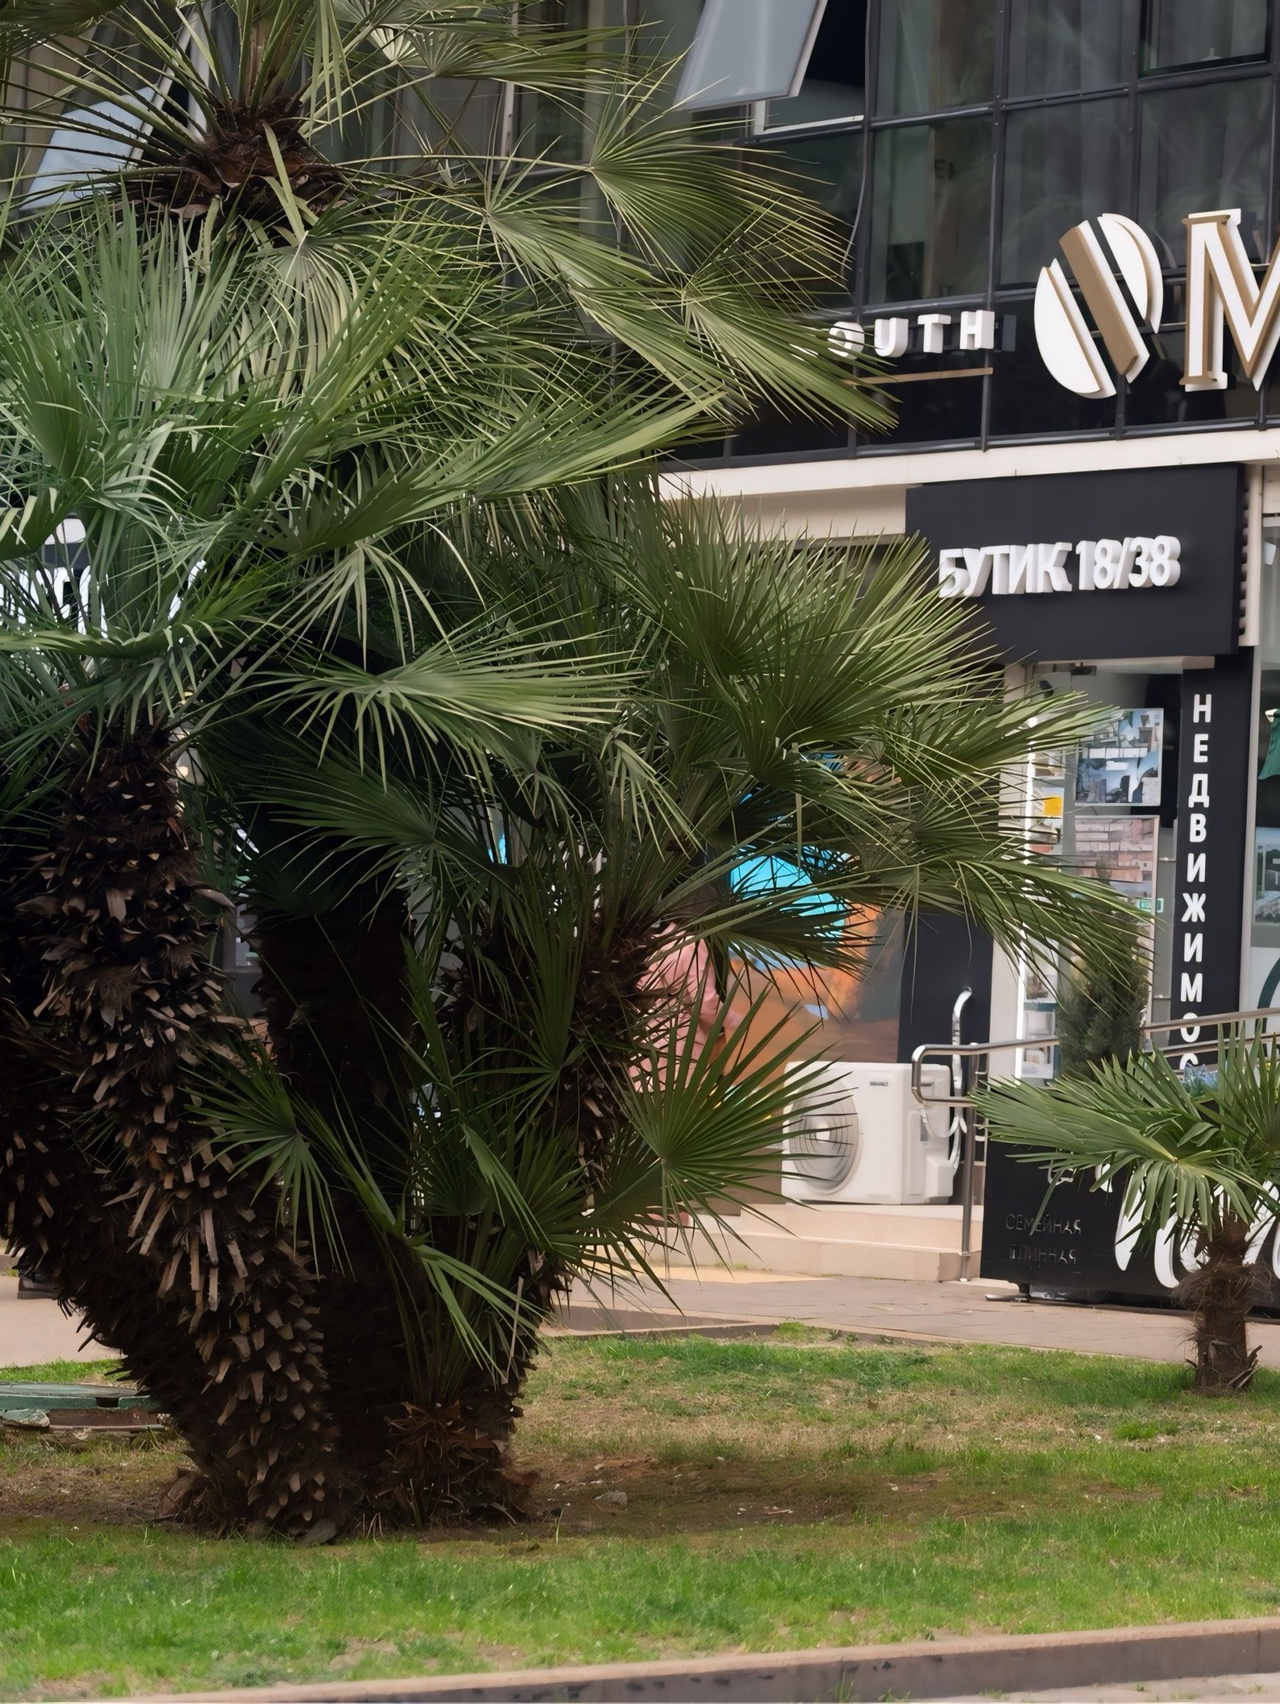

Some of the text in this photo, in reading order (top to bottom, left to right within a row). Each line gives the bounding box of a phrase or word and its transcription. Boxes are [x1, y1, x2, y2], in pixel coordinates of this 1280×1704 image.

[788, 309, 995, 360] OUTH
[939, 535, 1182, 597] БУТИК 18/38
